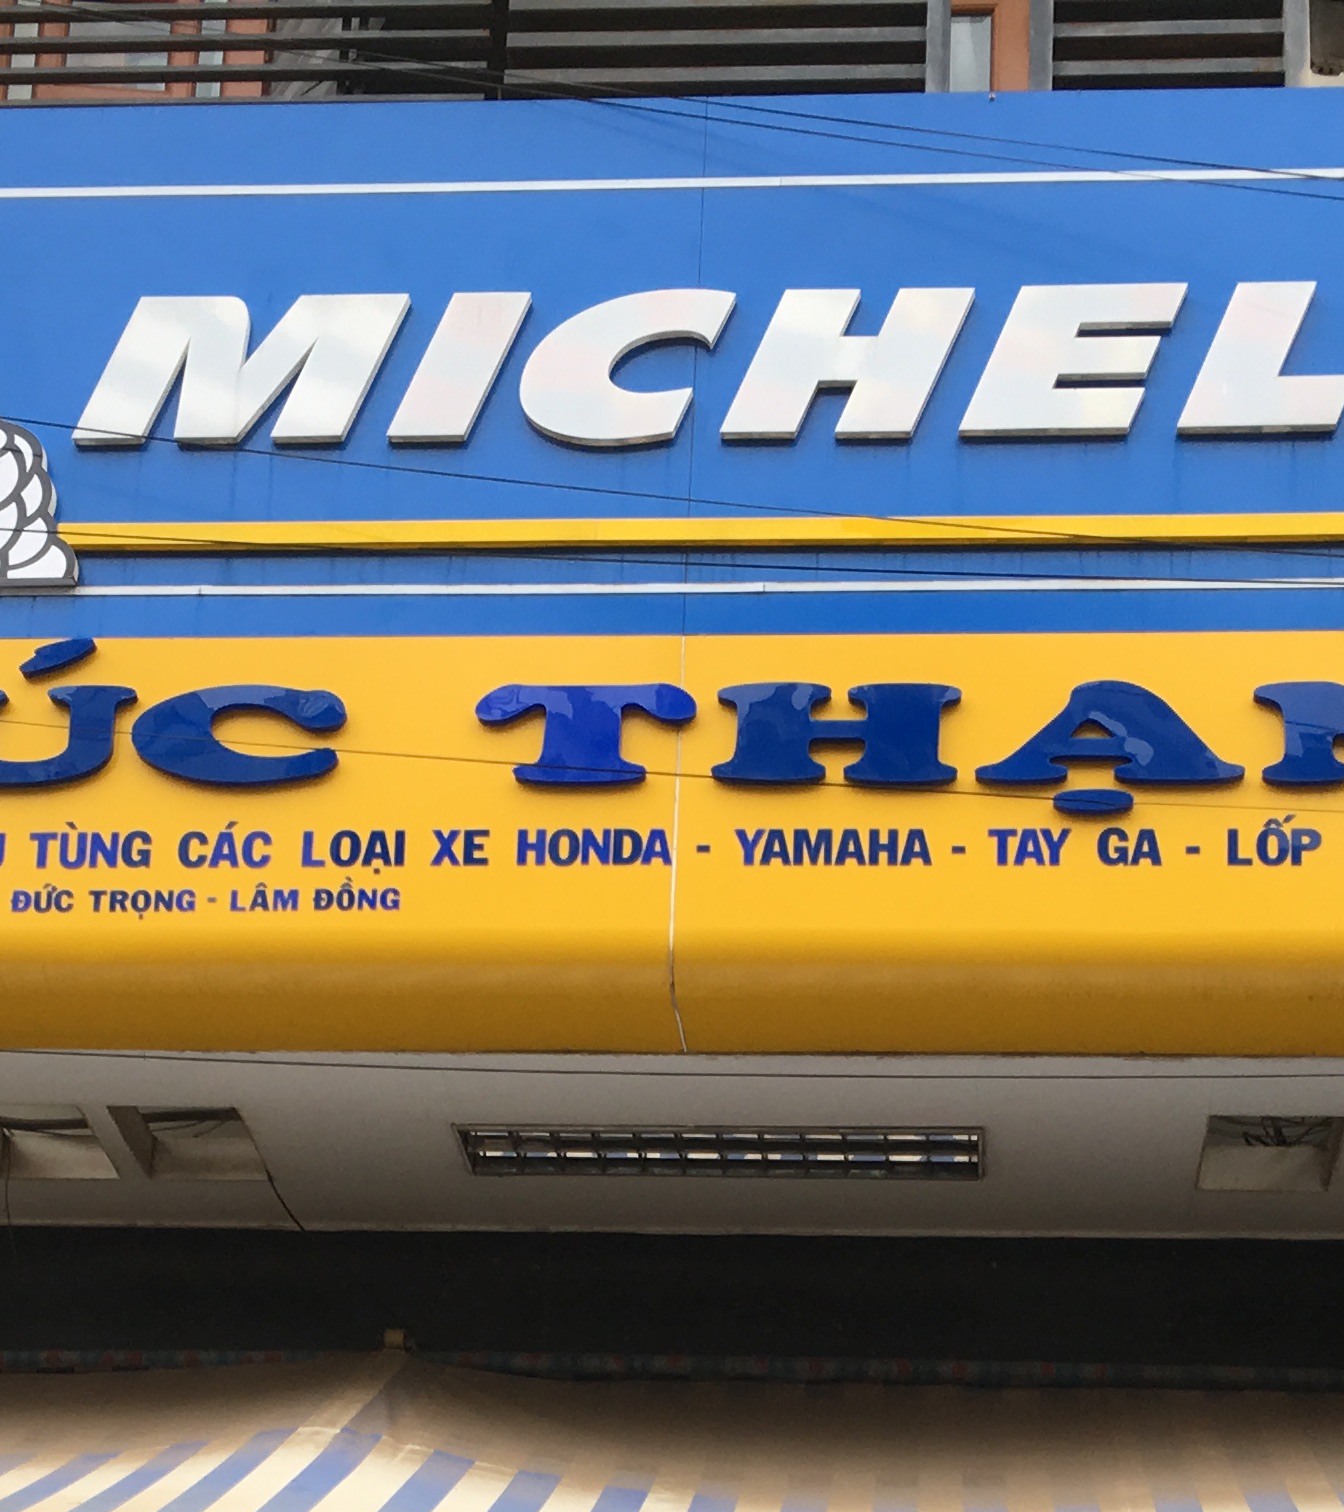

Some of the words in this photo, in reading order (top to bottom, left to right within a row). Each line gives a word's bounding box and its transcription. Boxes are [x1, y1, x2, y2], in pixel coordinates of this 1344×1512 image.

[29, 821, 152, 869] TÙNG
[178, 820, 273, 869] CÁC
[301, 829, 406, 875] LOẠI
[430, 829, 490, 867] XE
[517, 828, 672, 867] HONDA
[735, 828, 933, 867] YAMAHA
[987, 827, 1072, 867] TAY
[1097, 826, 1163, 867] GA
[1228, 813, 1322, 867] LỐP
[10, 883, 74, 914] ĐỨC
[89, 888, 196, 920] TRỌNG
[229, 882, 300, 913] LÂM
[313, 876, 401, 912] ĐỒNG
